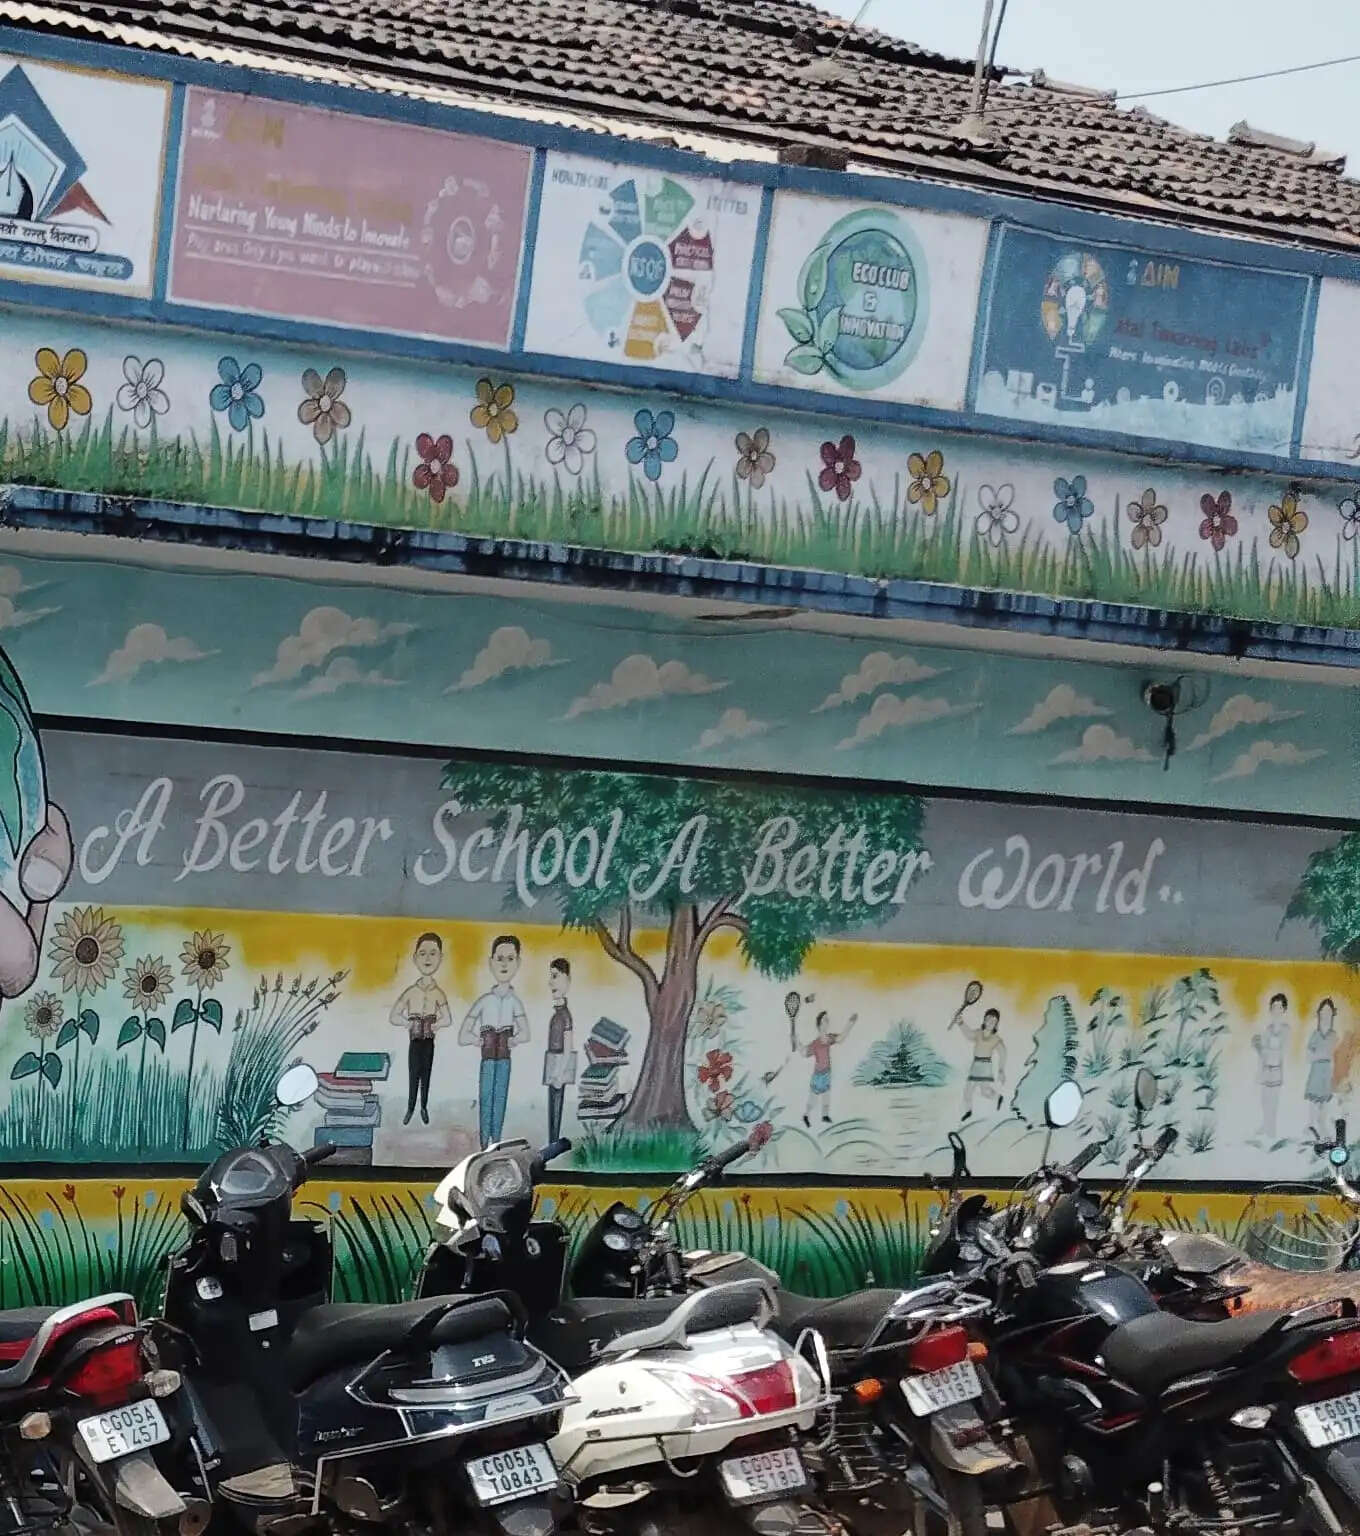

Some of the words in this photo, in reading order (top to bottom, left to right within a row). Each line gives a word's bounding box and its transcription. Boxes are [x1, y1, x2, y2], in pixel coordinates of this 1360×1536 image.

[265, 206, 298, 238] Young
[79, 776, 175, 885] A
[173, 773, 395, 882] Better
[414, 798, 624, 908] School
[628, 814, 710, 902] A
[737, 815, 935, 906] Better
[99, 1404, 155, 1435] CG05A
[1314, 1396, 1360, 1421] CG05
[106, 1422, 159, 1454] E1457
[482, 1448, 537, 1476] CG05A
[488, 1467, 543, 1494] T0843
